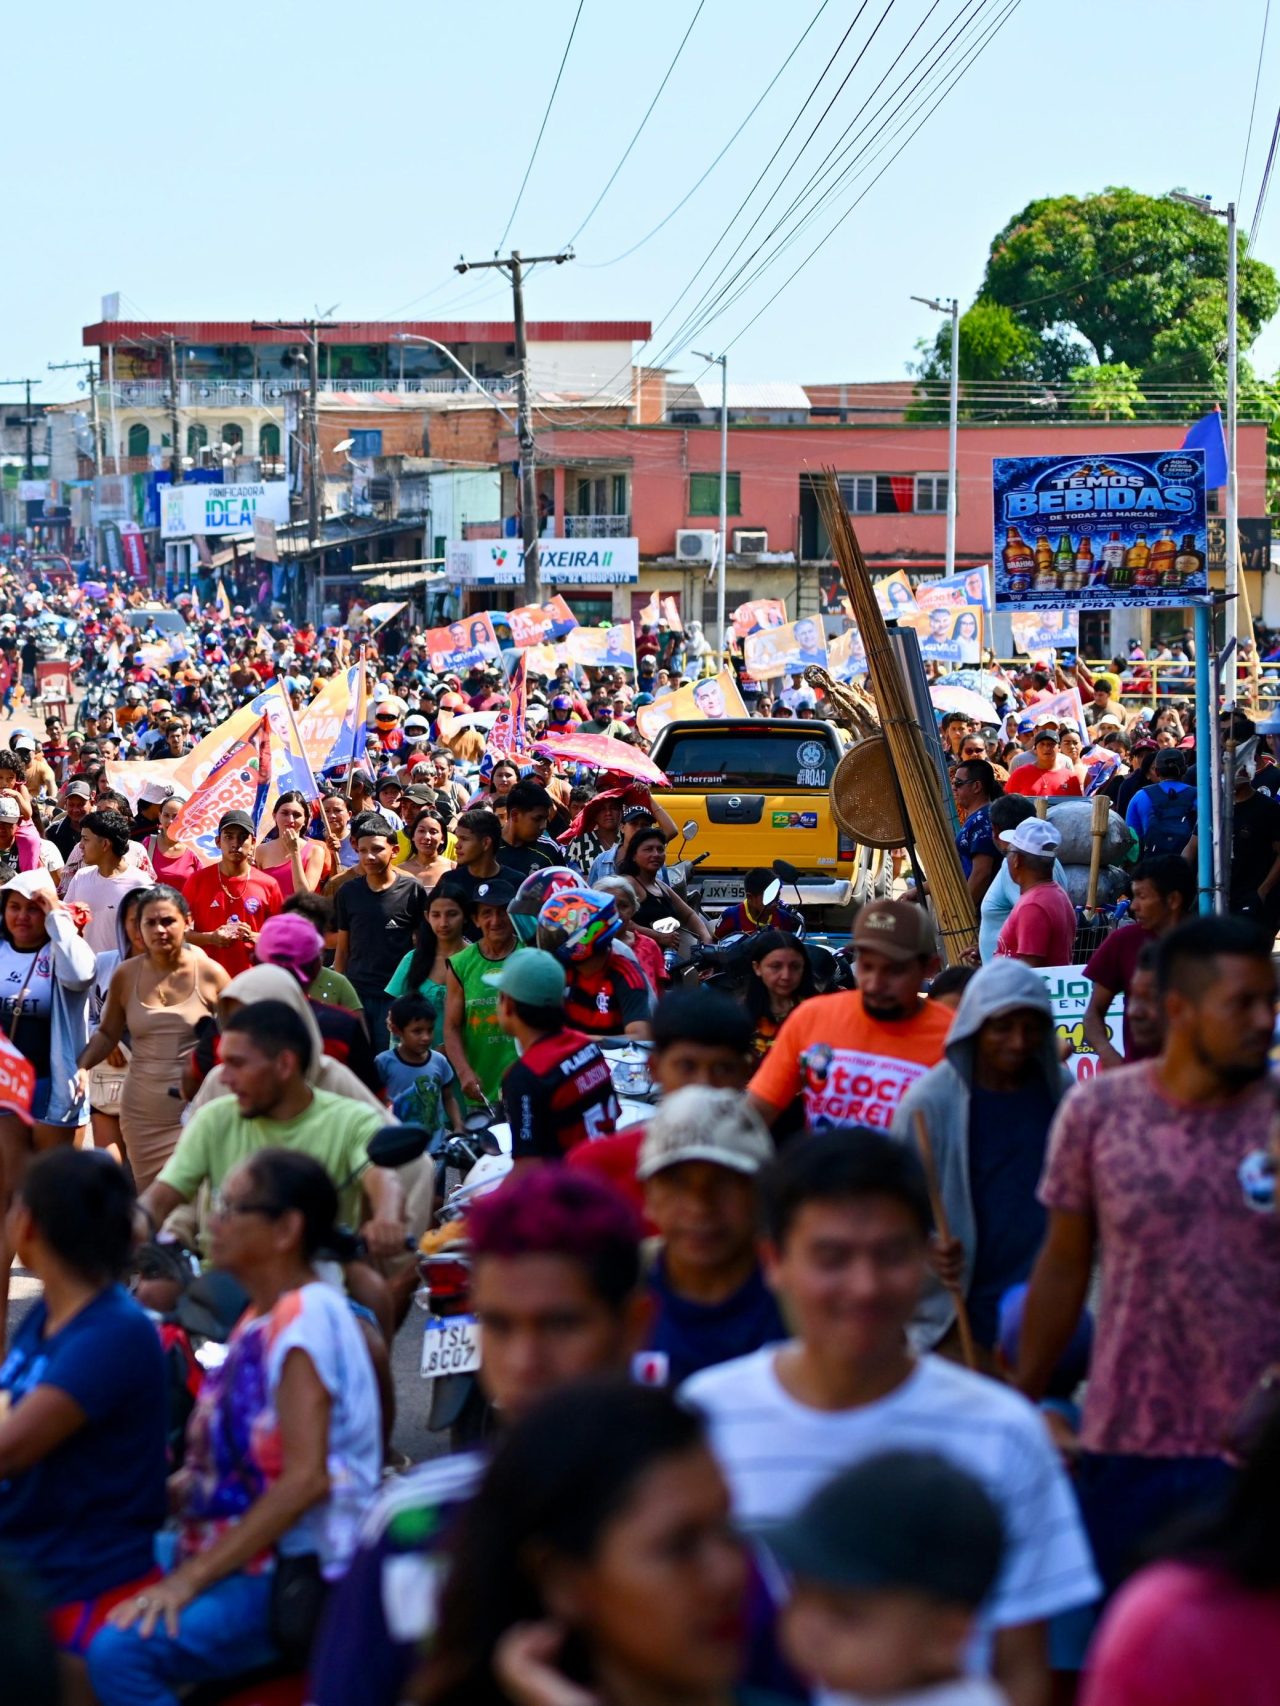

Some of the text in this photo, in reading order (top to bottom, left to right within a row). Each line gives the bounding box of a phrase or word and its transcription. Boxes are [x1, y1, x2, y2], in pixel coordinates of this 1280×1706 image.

[1051, 476, 1144, 490] TEMOS
[209, 486, 265, 498] PANIFICADORA
[1007, 486, 1193, 518] BEBIDAS
[517, 552, 599, 567] TIXEIRA
[1033, 602, 1076, 610] MAIS
[805, 769, 826, 786] ROAD
[773, 815, 789, 824] 22
[438, 1325, 471, 1349] TSL
